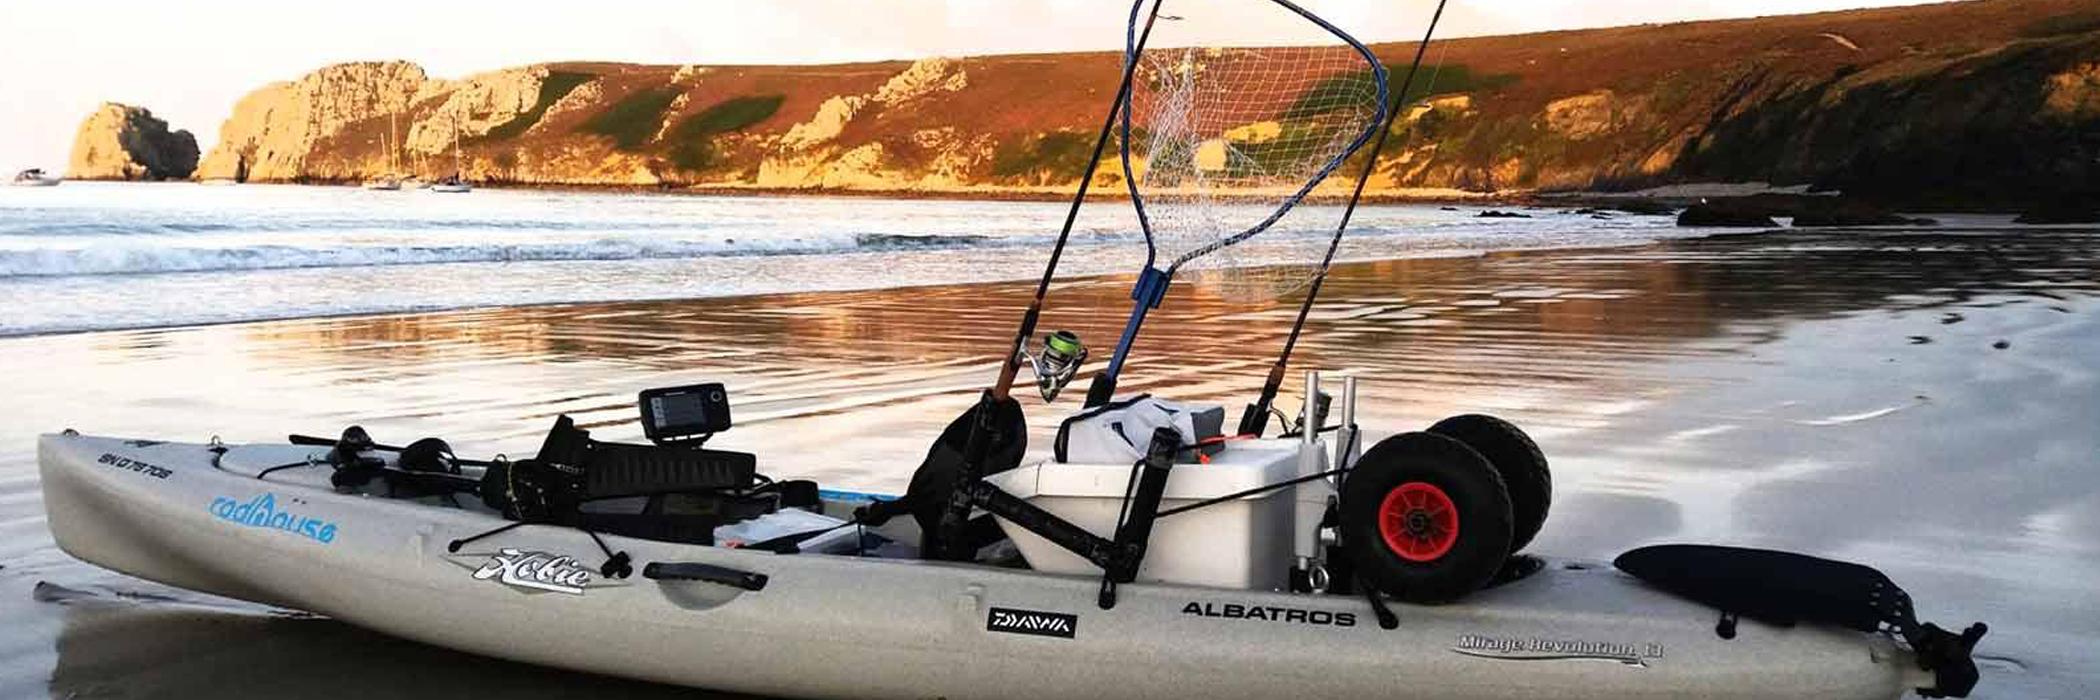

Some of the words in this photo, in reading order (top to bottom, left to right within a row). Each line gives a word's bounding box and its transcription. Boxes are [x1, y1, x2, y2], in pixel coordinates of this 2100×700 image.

[471, 548, 590, 594] Hobie
[1182, 602, 1357, 627] ALBATROS
[1458, 635, 1524, 653] Mirage
[1528, 637, 1636, 656] Revolution
